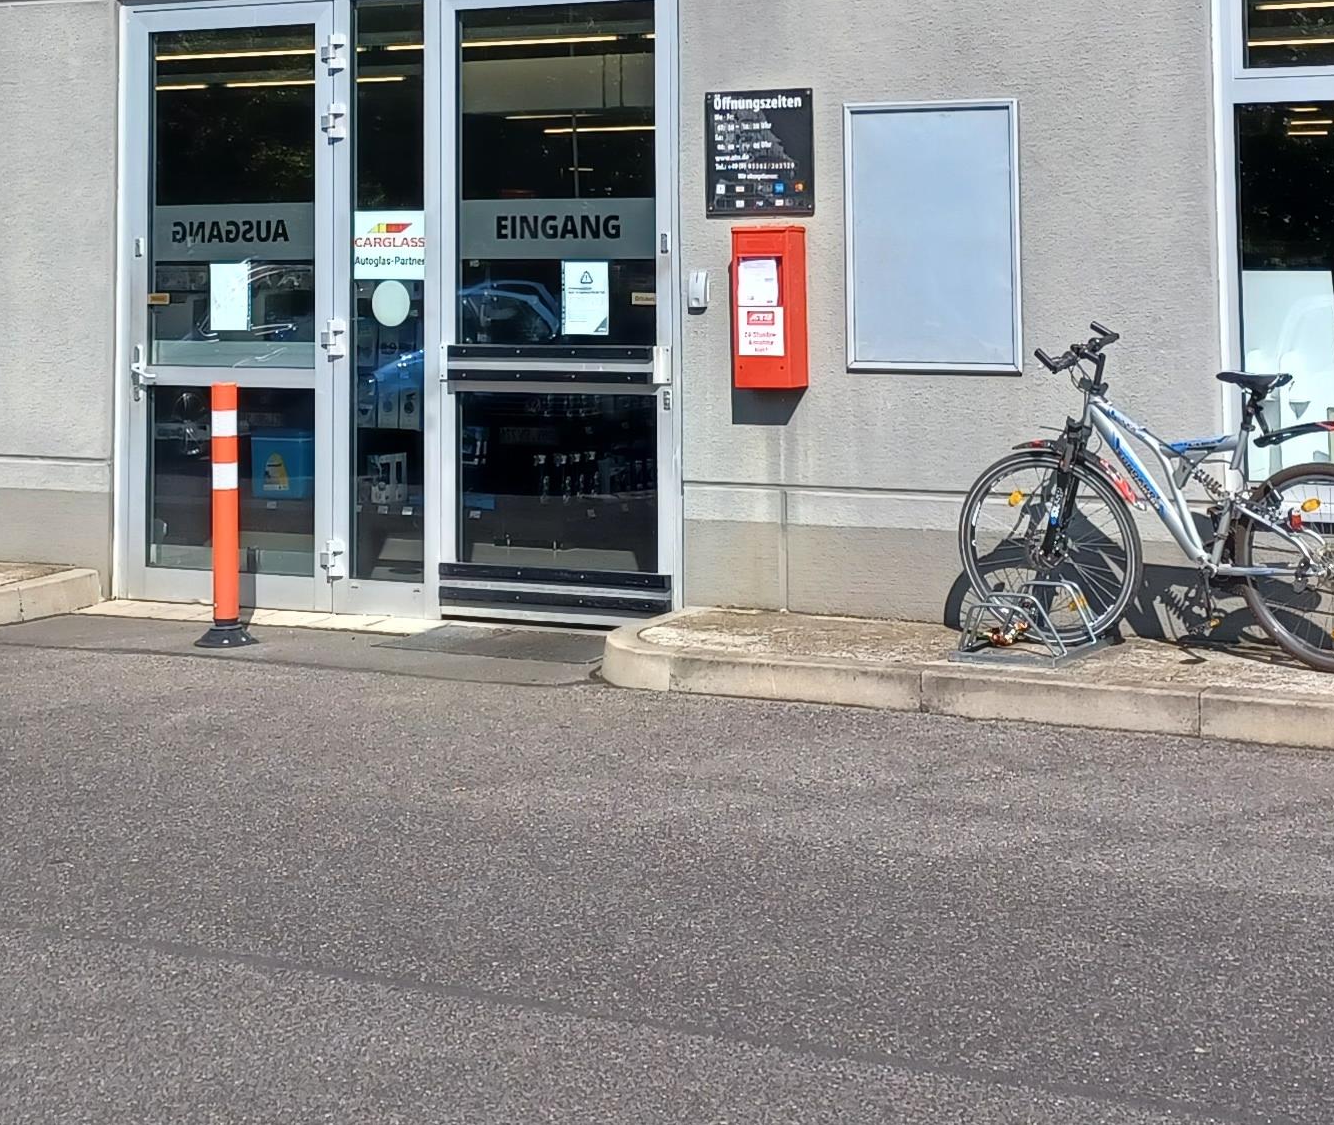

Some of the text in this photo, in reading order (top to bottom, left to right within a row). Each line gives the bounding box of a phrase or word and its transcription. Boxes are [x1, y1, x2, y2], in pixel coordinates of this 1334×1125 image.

[713, 94, 802, 113] Öffnungszeiten
[496, 215, 621, 240] EINGANG
[354, 237, 425, 248] CARGLASS
